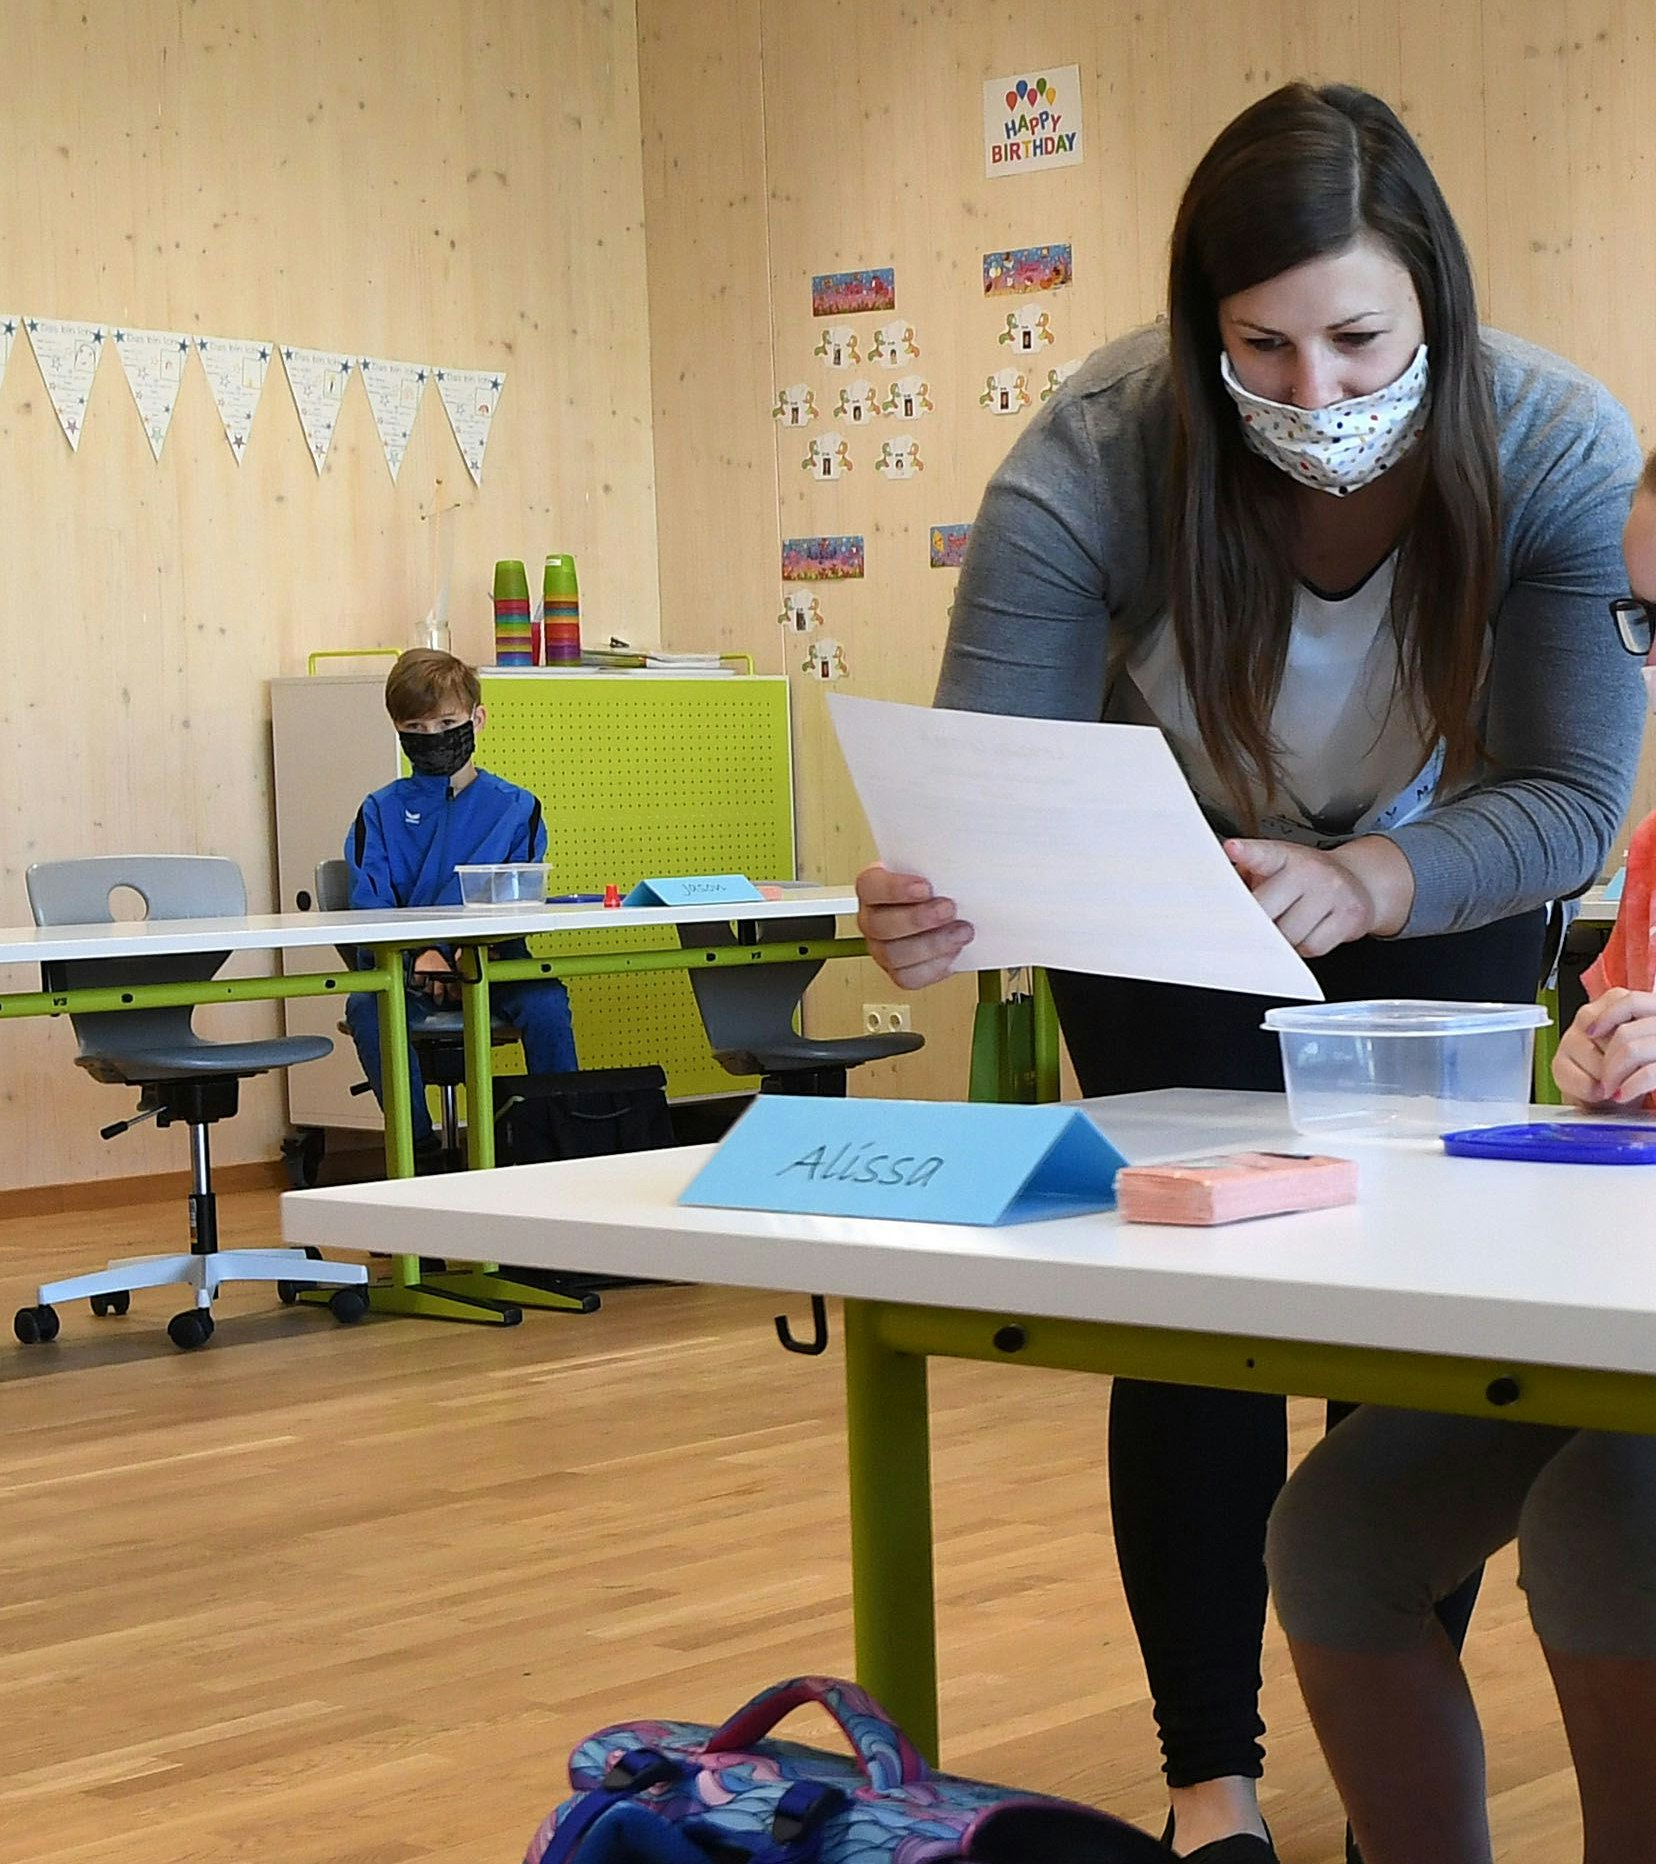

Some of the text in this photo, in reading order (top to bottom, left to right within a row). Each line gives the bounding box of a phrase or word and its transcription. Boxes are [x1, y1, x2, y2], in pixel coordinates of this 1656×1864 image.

[1004, 110, 1062, 140] HAPPY
[991, 132, 1076, 164] BIRTHDAY
[775, 1141, 945, 1188] Alissa
